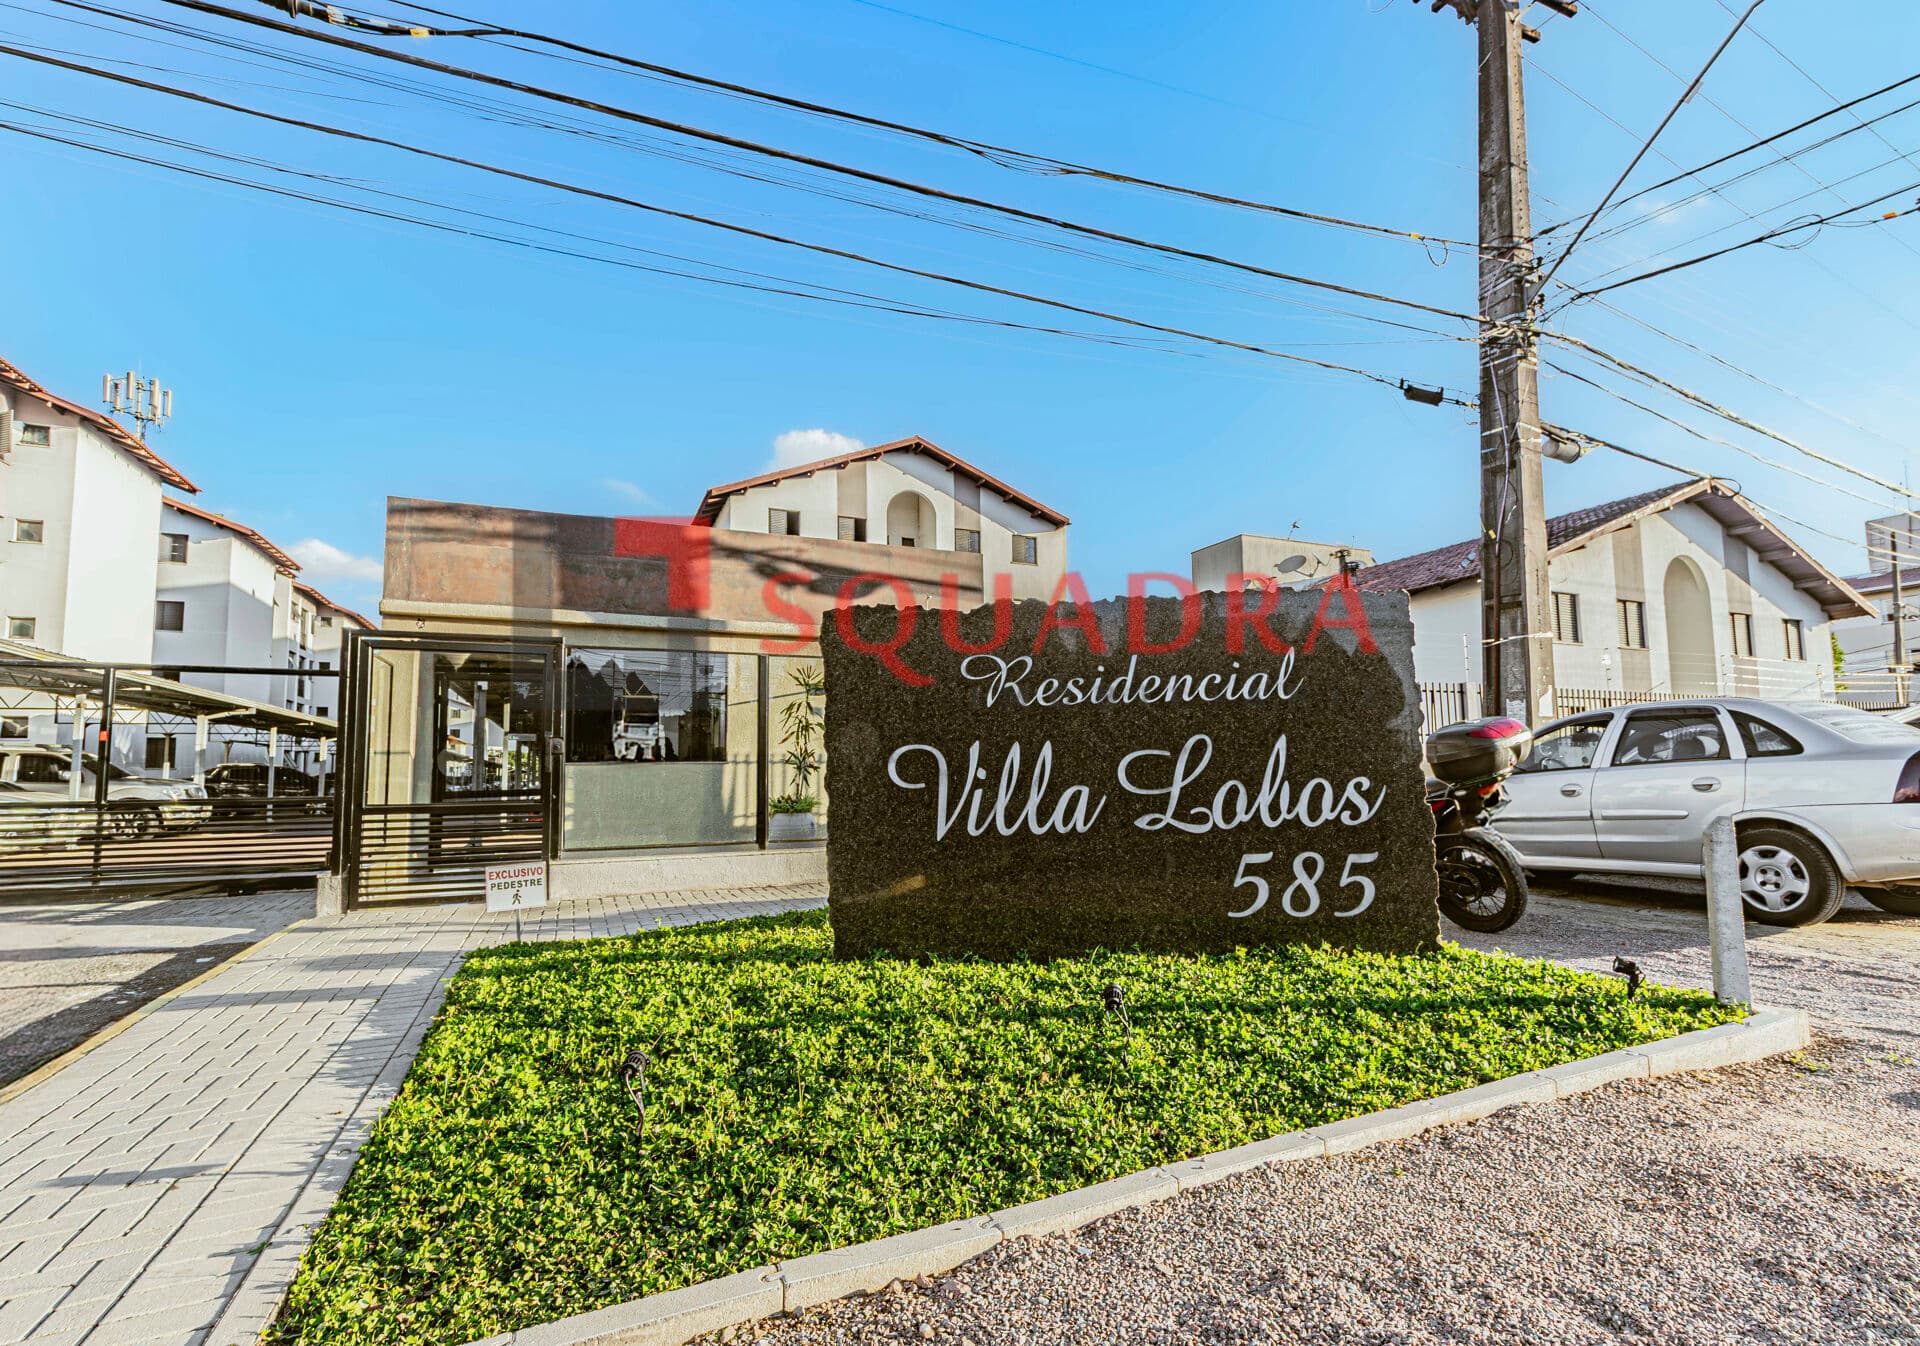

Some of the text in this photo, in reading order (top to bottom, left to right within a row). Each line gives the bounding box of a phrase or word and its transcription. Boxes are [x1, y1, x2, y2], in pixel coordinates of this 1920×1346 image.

[960, 646, 1305, 708] Residencial
[887, 733, 1387, 842] Villa Lobos
[488, 866, 544, 881] EXCLUSIVO
[490, 878, 543, 891] PEDESTRE
[1227, 851, 1379, 918] 585
